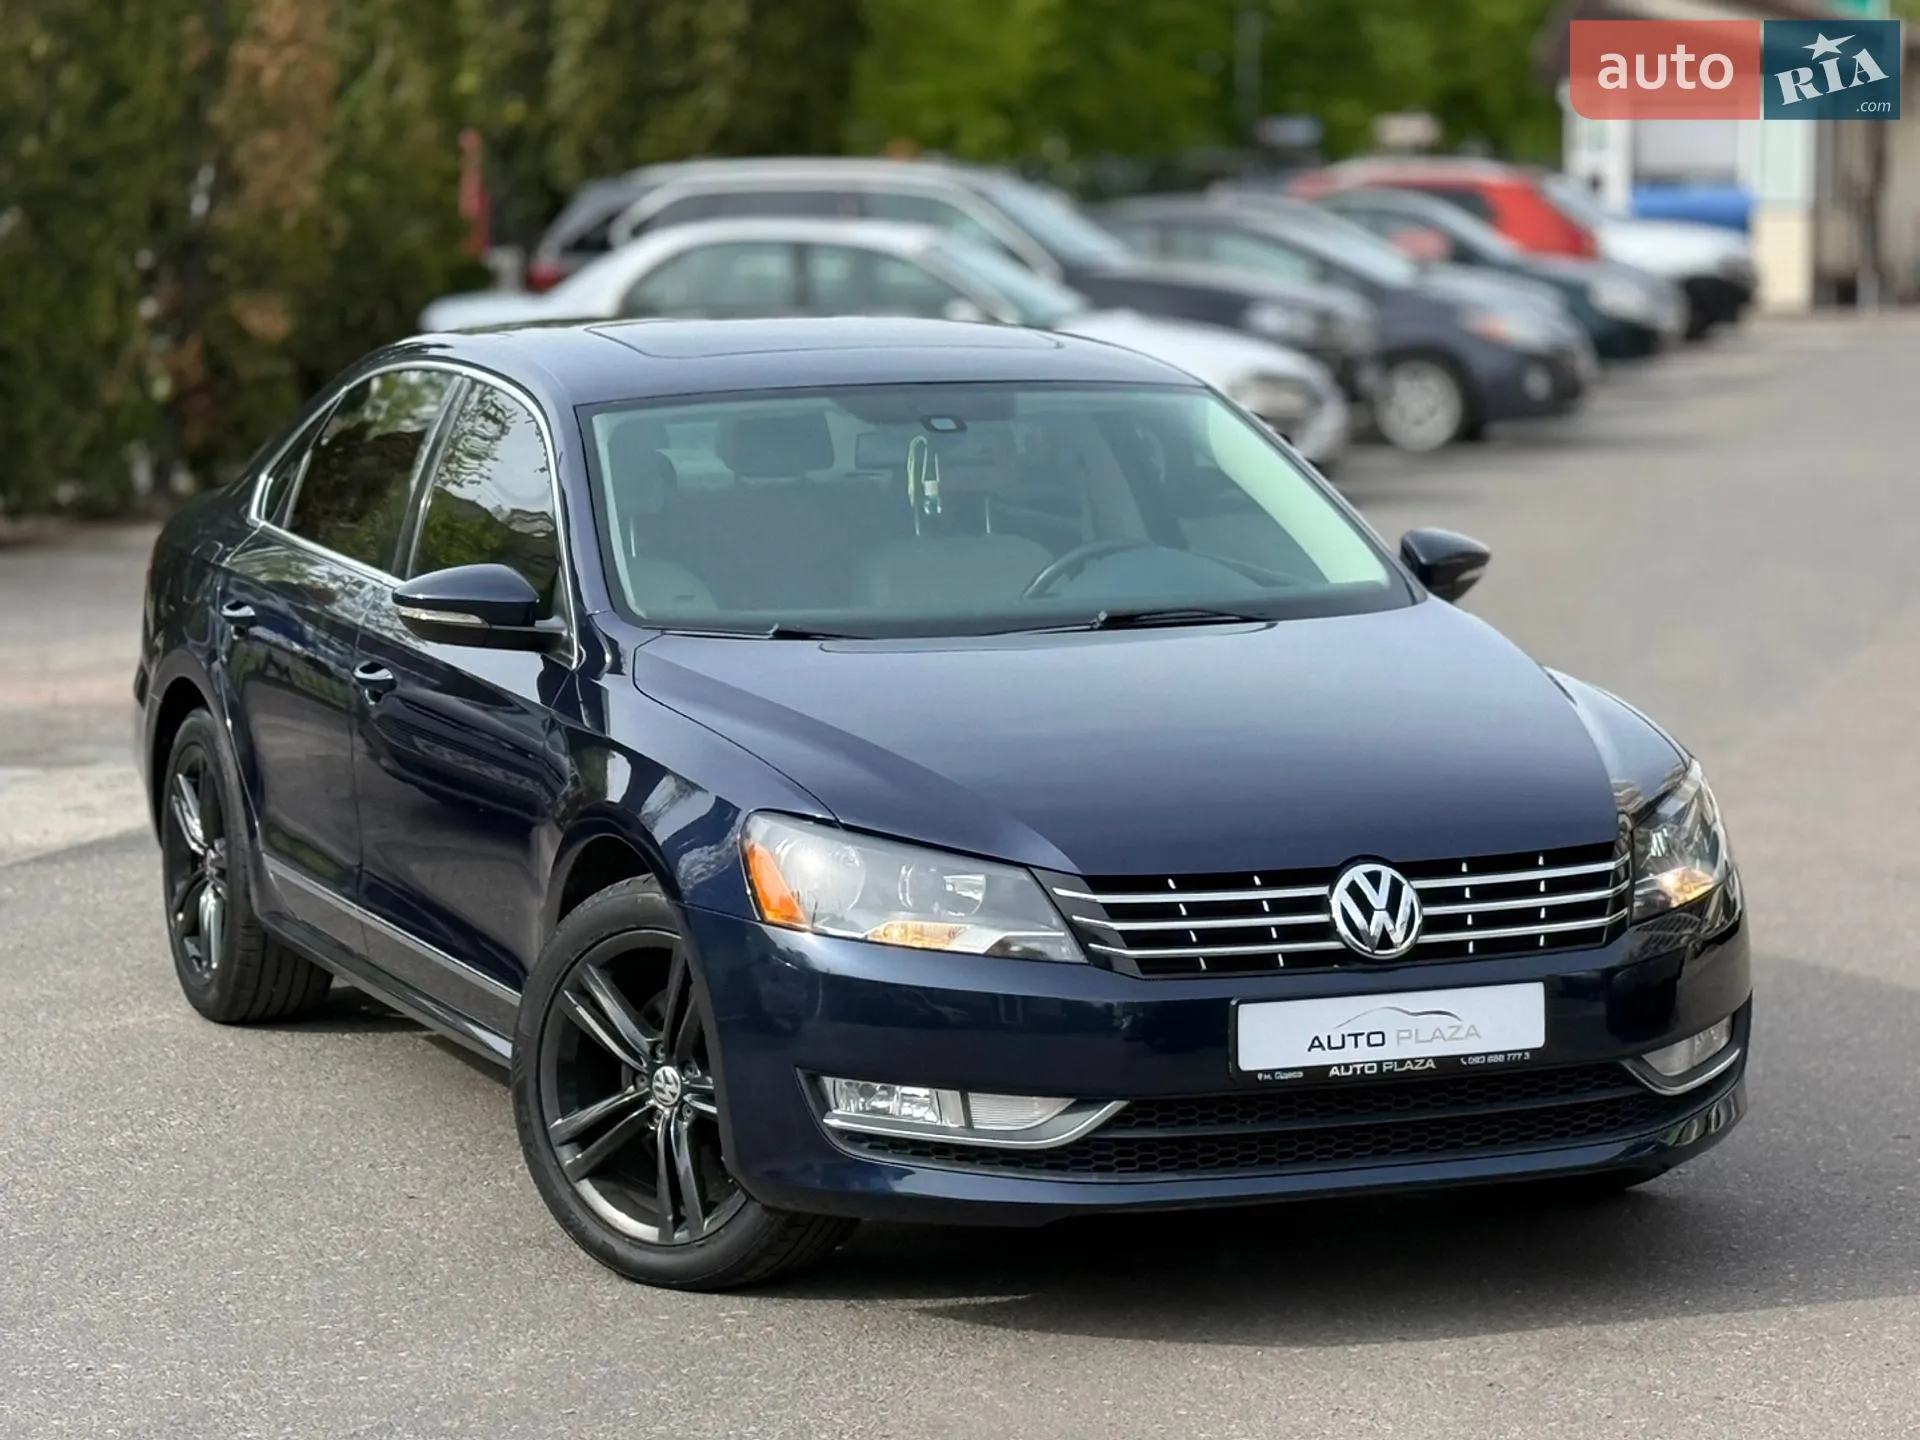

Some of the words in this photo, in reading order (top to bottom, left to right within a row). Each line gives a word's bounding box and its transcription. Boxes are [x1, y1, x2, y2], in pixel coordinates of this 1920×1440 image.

[1306, 1030, 1386, 1052] AUTO
[1396, 1024, 1482, 1047] PLAZA
[1328, 1062, 1378, 1078] AUTO
[1382, 1058, 1437, 1073] PLAZA
